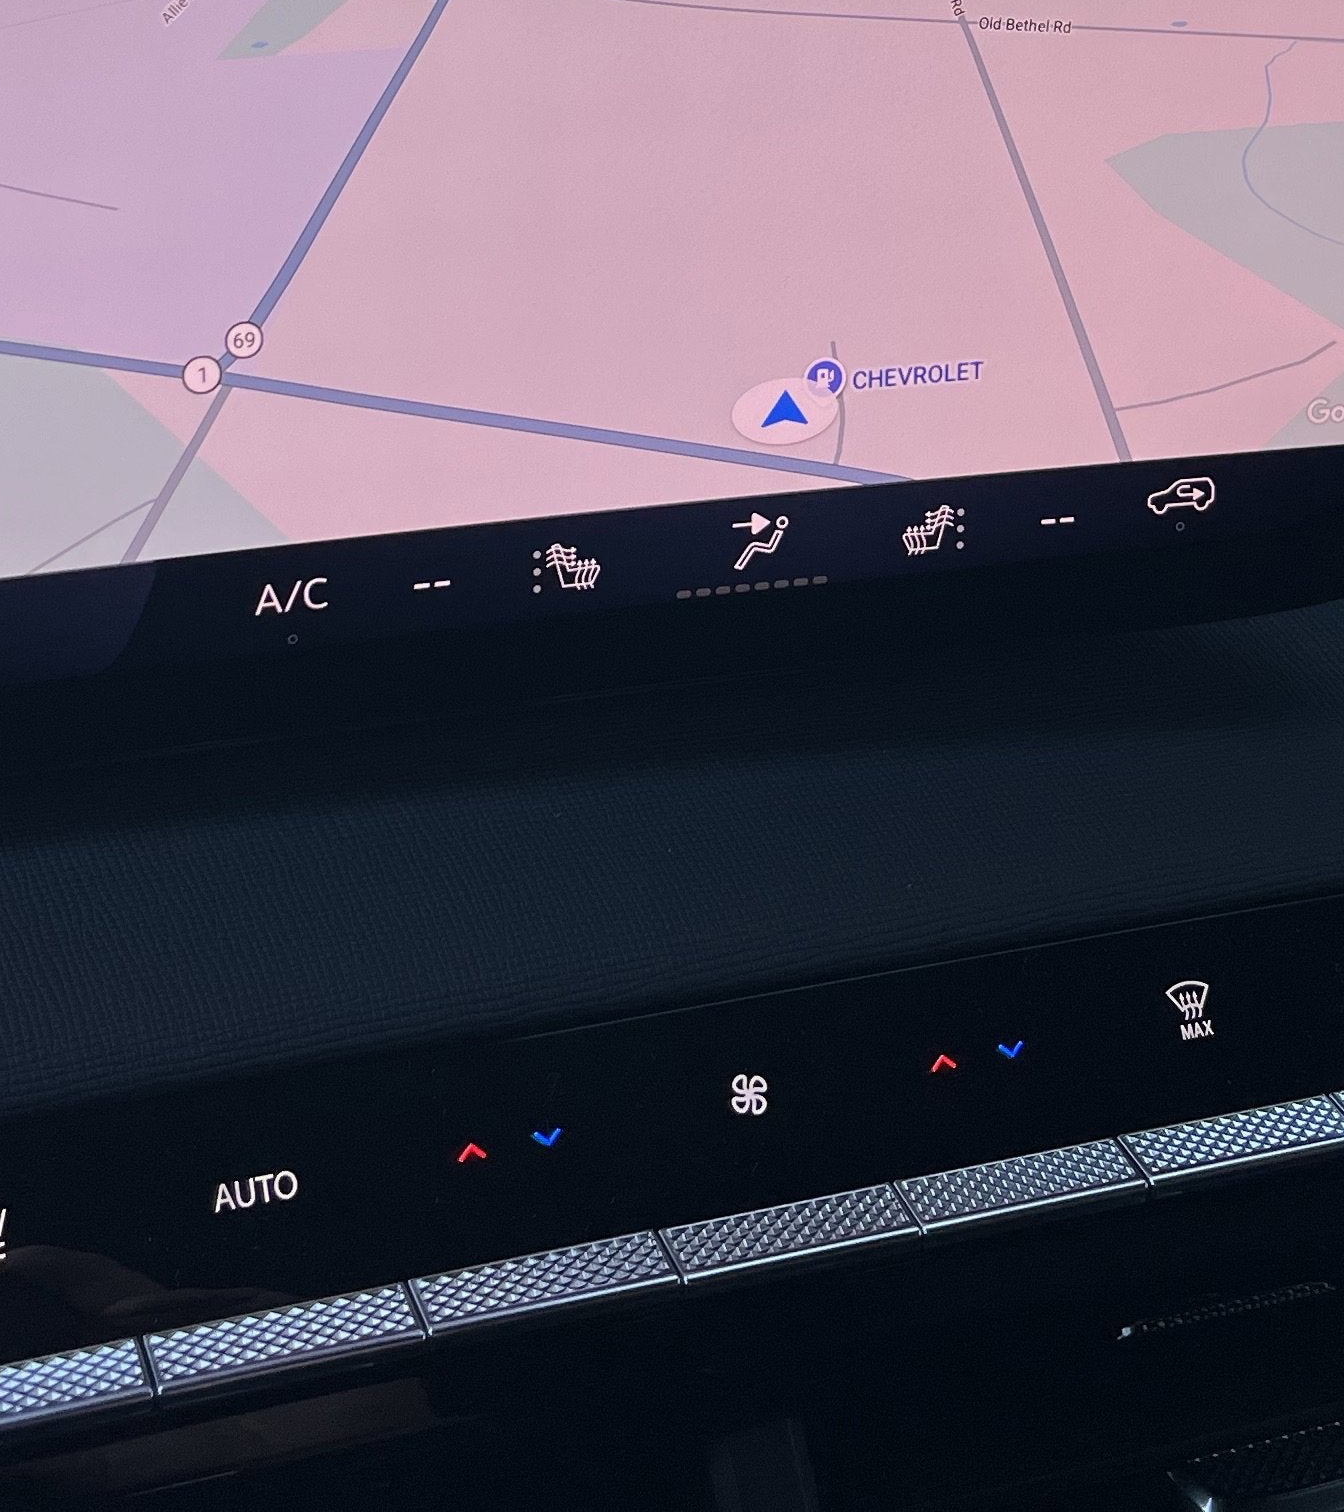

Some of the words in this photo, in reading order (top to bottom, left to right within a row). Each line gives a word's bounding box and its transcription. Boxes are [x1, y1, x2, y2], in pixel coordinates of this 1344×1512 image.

[979, 16, 1002, 31] Old
[1006, 18, 1049, 33] Bethel
[1053, 20, 1072, 34] Rd
[233, 330, 256, 350] 69
[852, 361, 984, 390] CHEVROLET
[255, 578, 329, 617] A/C
[1179, 1020, 1213, 1040] MAX
[213, 1170, 299, 1213] AUTO
